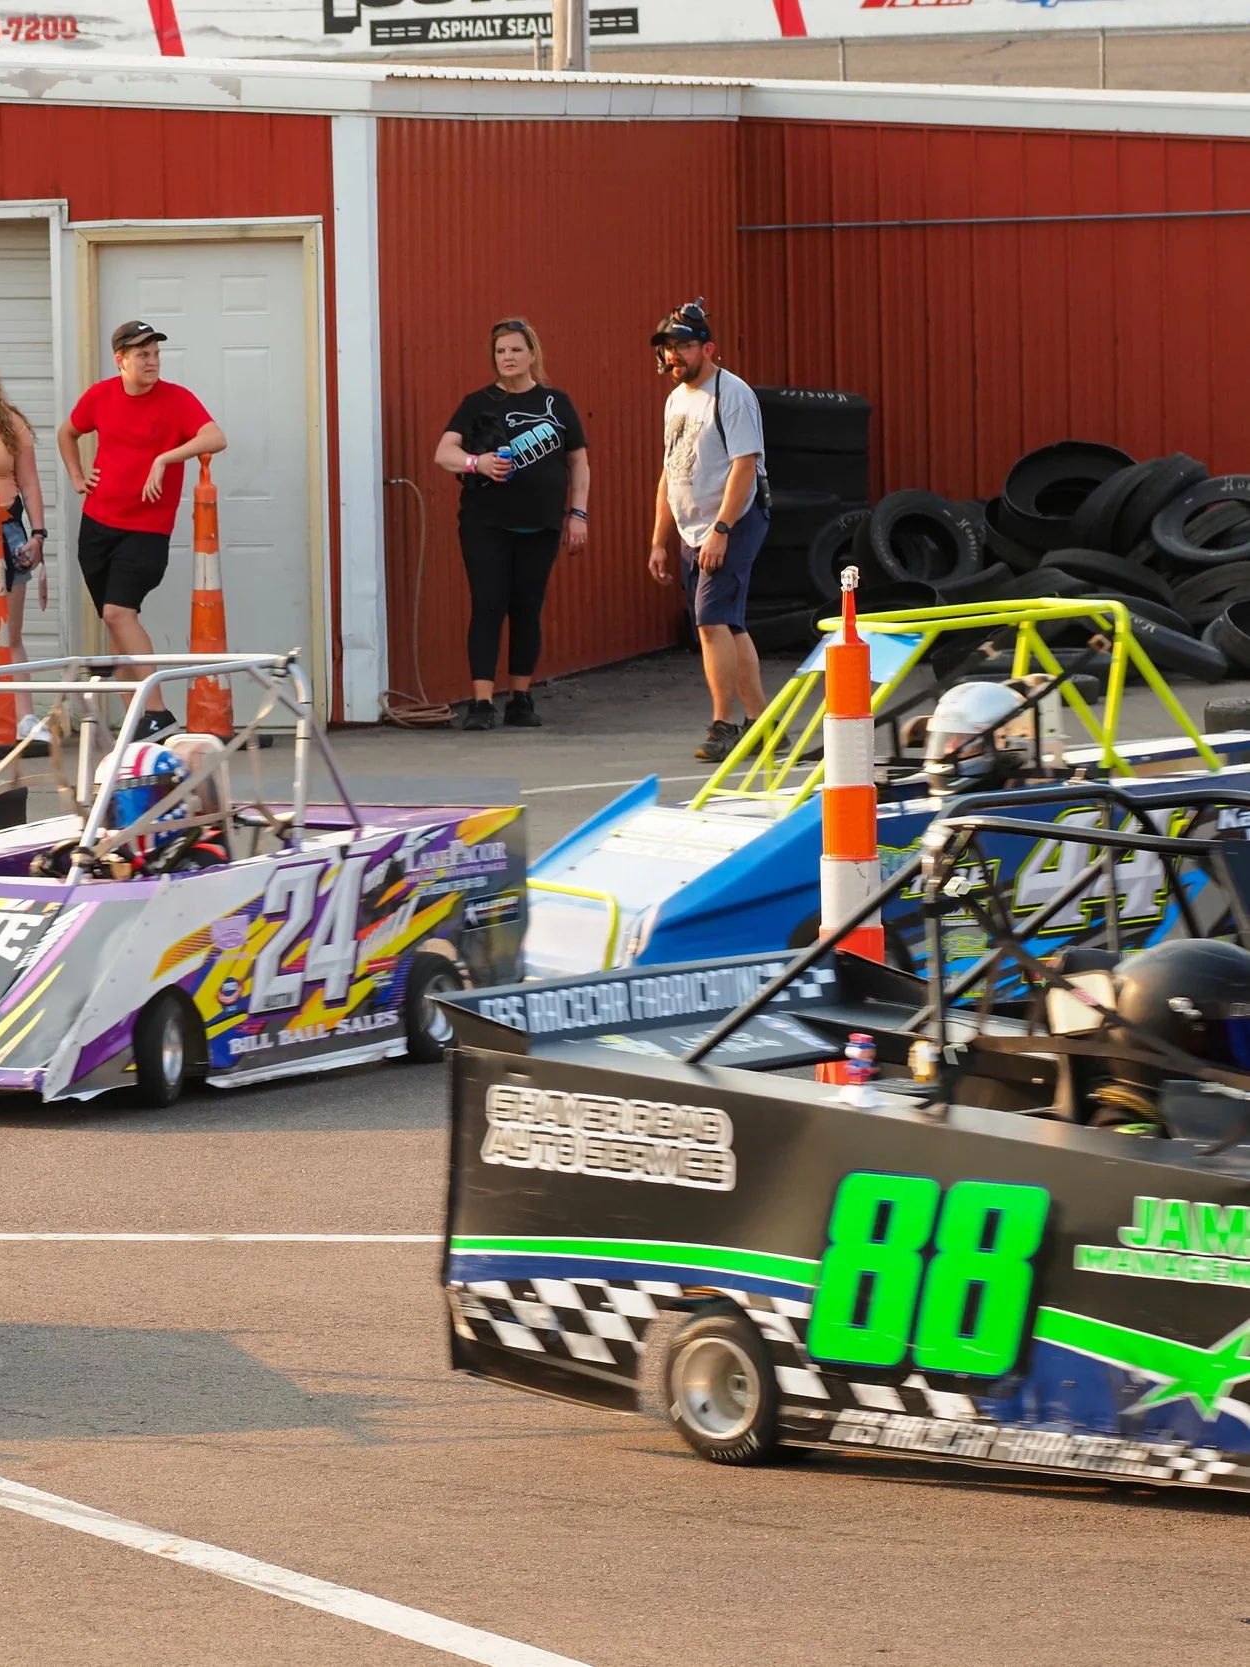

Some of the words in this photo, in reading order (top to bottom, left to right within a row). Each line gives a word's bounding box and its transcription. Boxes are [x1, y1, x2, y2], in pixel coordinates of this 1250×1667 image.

[428, 18, 503, 40] ASPHALT
[507, 17, 553, 36] SEALI
[509, 422, 561, 471] MA
[1011, 805, 1184, 935] 44
[250, 852, 371, 1014] 24
[227, 1033, 275, 1055] BILL
[335, 1010, 400, 1036] SALES
[807, 1168, 1051, 1378] 88
